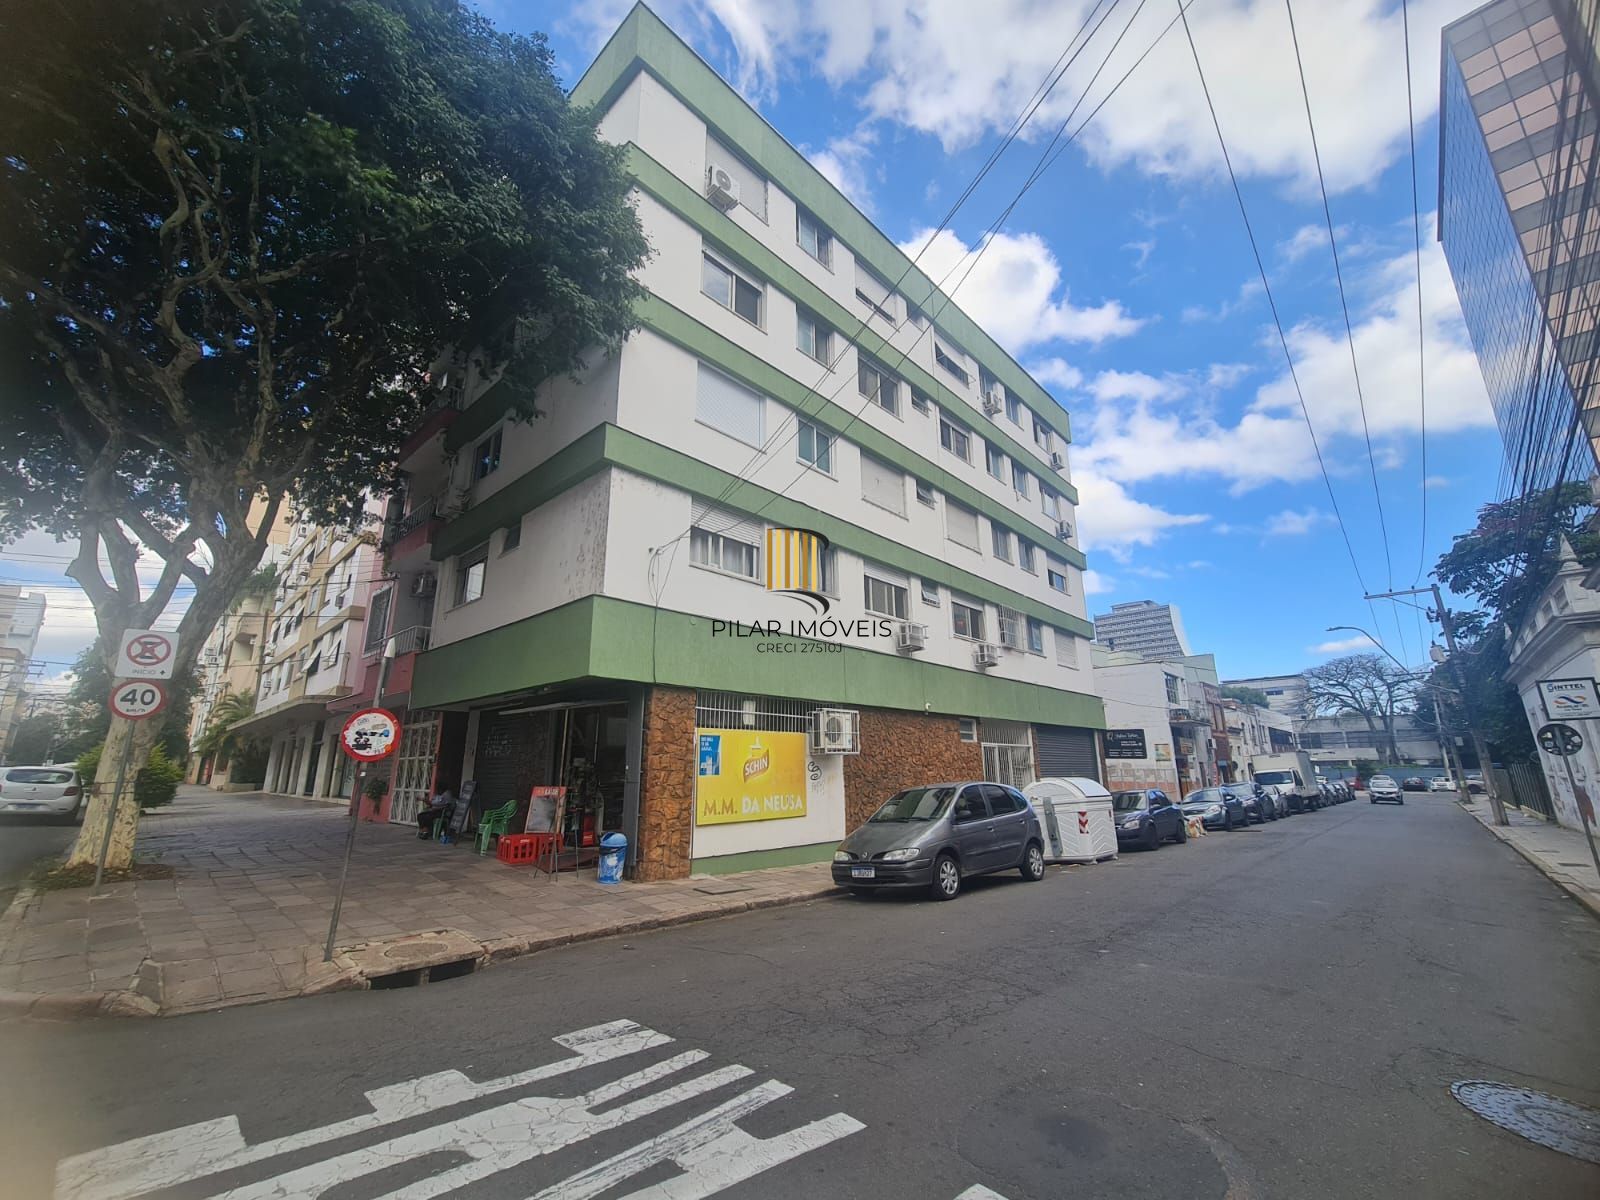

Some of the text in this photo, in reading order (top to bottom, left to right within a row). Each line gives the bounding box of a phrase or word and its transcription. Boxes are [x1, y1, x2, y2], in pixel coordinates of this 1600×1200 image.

[120, 688, 156, 706] 40
[744, 756, 768, 777] SCHIN
[703, 793, 803, 817] M.M. DA NEUSA
